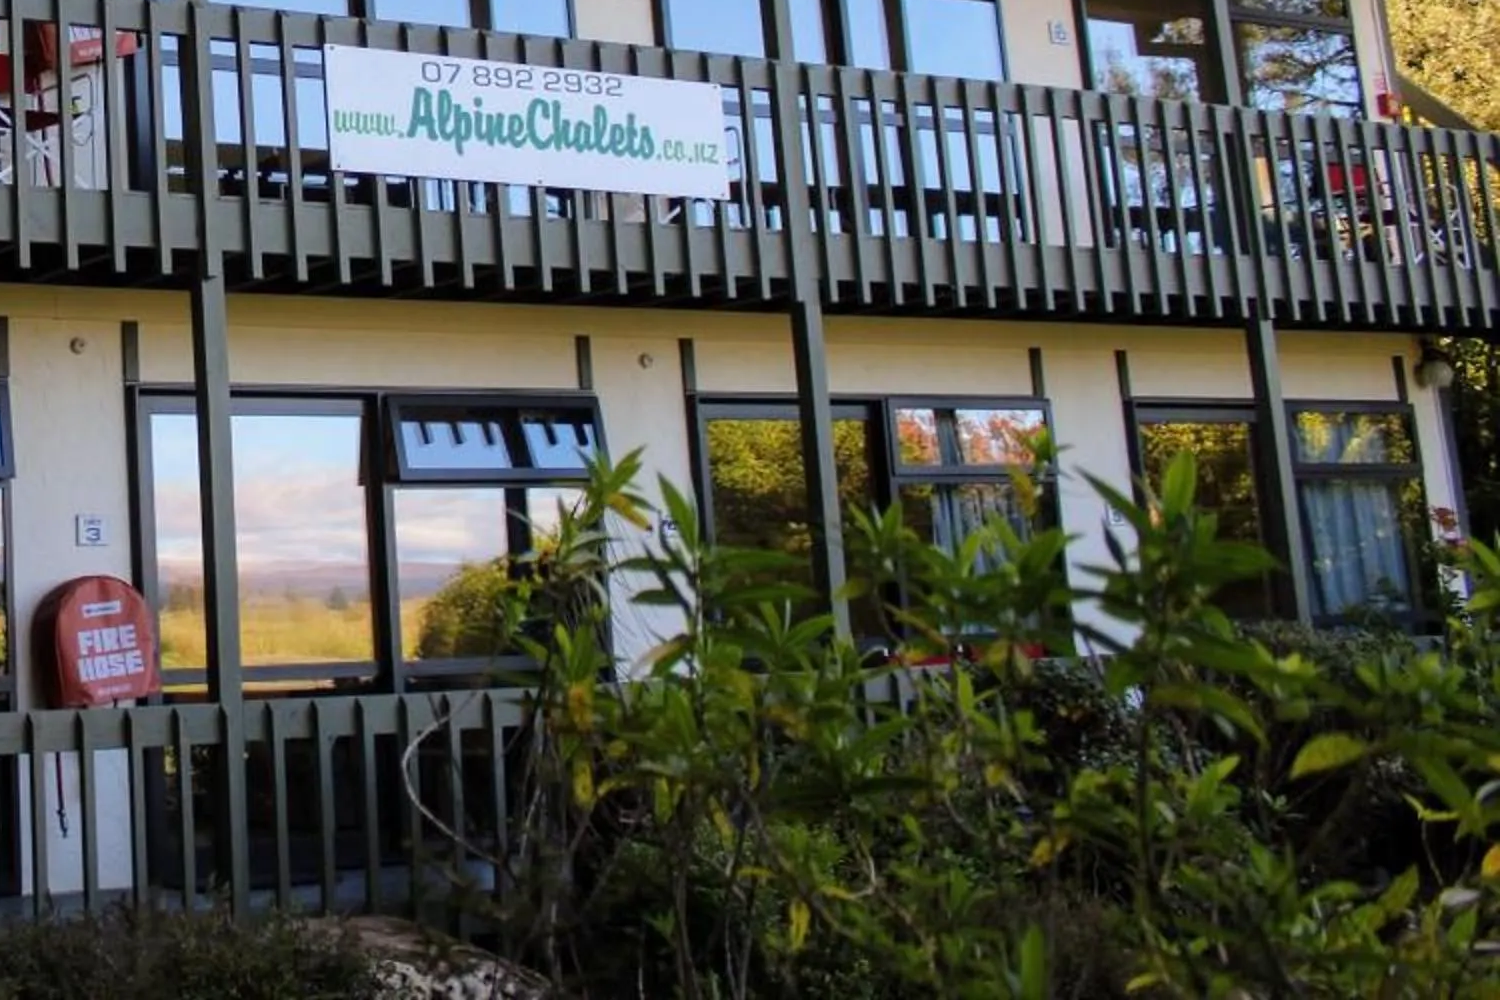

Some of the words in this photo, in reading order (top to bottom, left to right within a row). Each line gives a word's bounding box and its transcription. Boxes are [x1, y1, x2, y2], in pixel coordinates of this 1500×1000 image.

[421, 61, 461, 84] 07
[473, 65, 534, 90] 892
[543, 71, 623, 97] 2932
[333, 86, 720, 165] www.AlpineChalets.co.nz
[85, 527, 101, 541] 3
[78, 624, 137, 655] FIRE
[78, 650, 145, 683] HOSE
